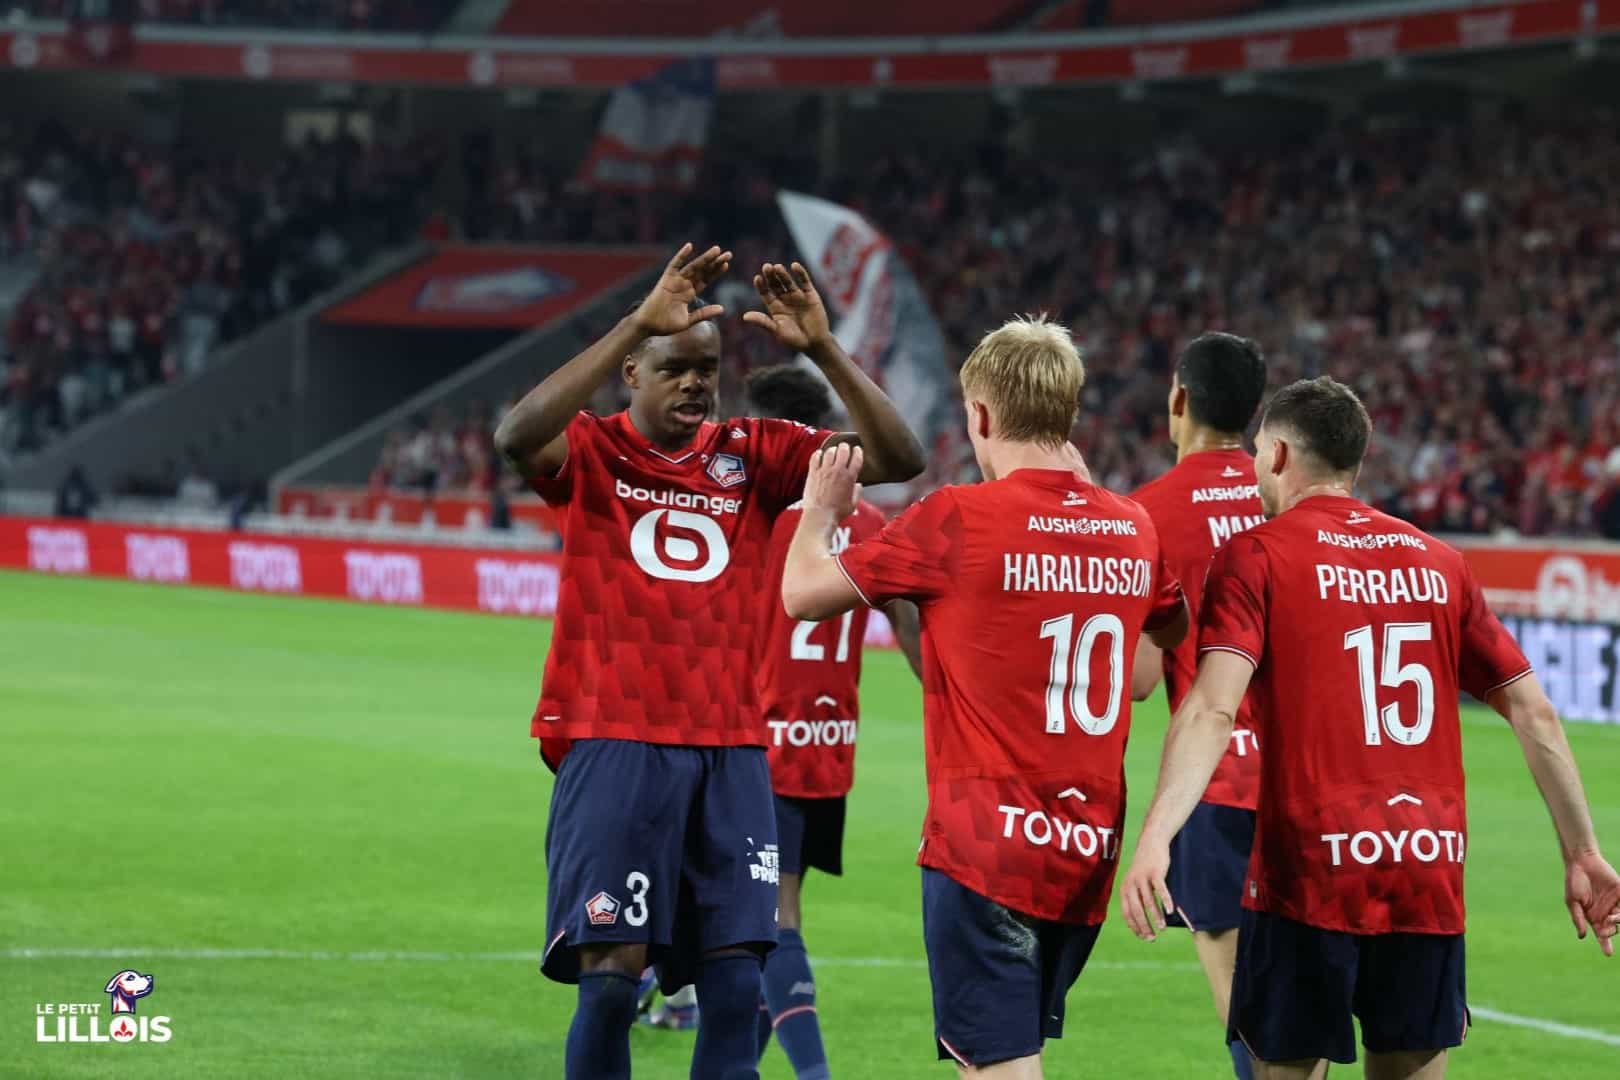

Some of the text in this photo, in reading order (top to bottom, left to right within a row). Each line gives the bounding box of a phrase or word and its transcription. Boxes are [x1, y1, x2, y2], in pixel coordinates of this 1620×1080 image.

[615, 479, 742, 515] boulanger
[1027, 515, 1137, 536] AUSHOPPING
[1317, 529, 1427, 551] AUSHOPPING
[1003, 553, 1151, 598] HARALDSSON
[1316, 564, 1448, 604] PERRAUD
[1039, 612, 1125, 735] 10
[1343, 621, 1435, 746] 15
[624, 871, 650, 927] 3
